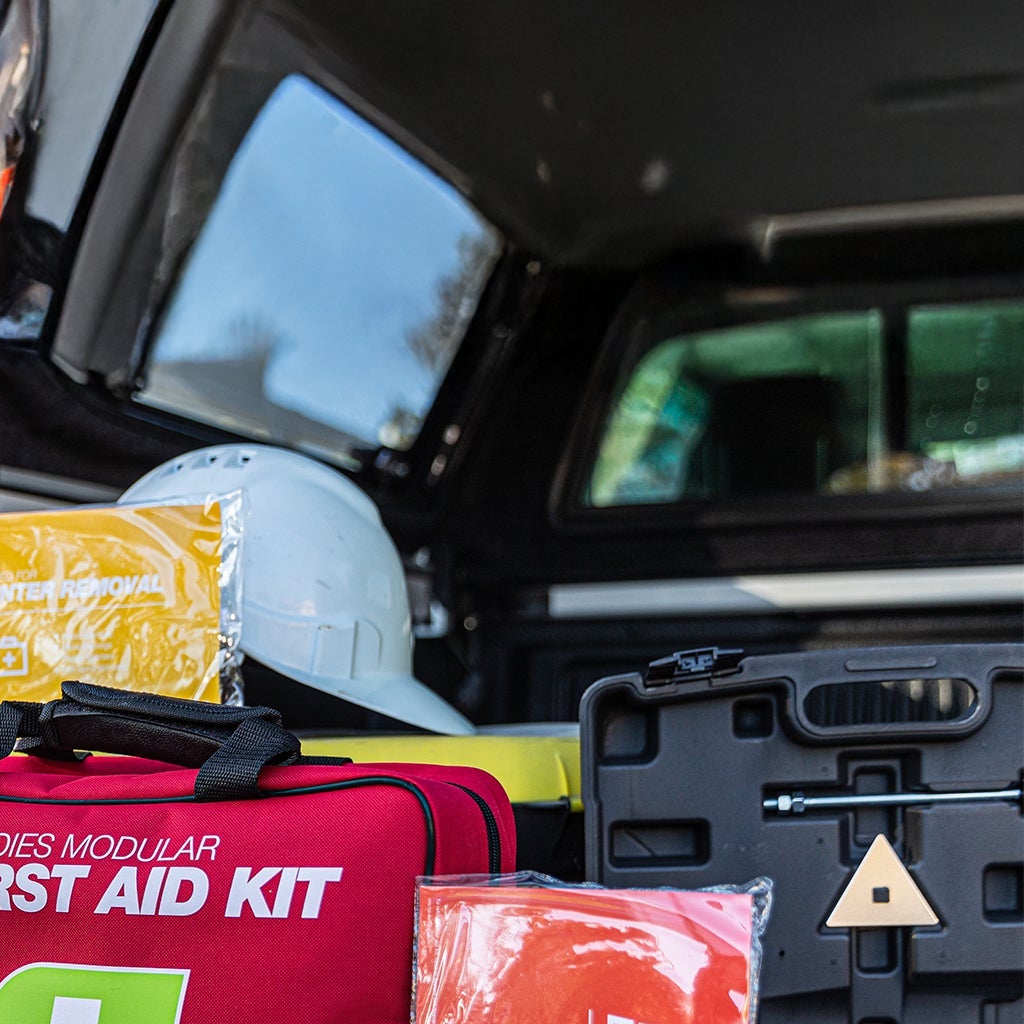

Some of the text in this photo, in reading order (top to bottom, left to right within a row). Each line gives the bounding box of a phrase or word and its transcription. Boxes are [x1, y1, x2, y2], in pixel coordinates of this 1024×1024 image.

[59, 574, 164, 600] REMOVAL
[61, 834, 221, 862] MODULAR
[94, 866, 209, 917] AID
[225, 866, 344, 919] KIT
